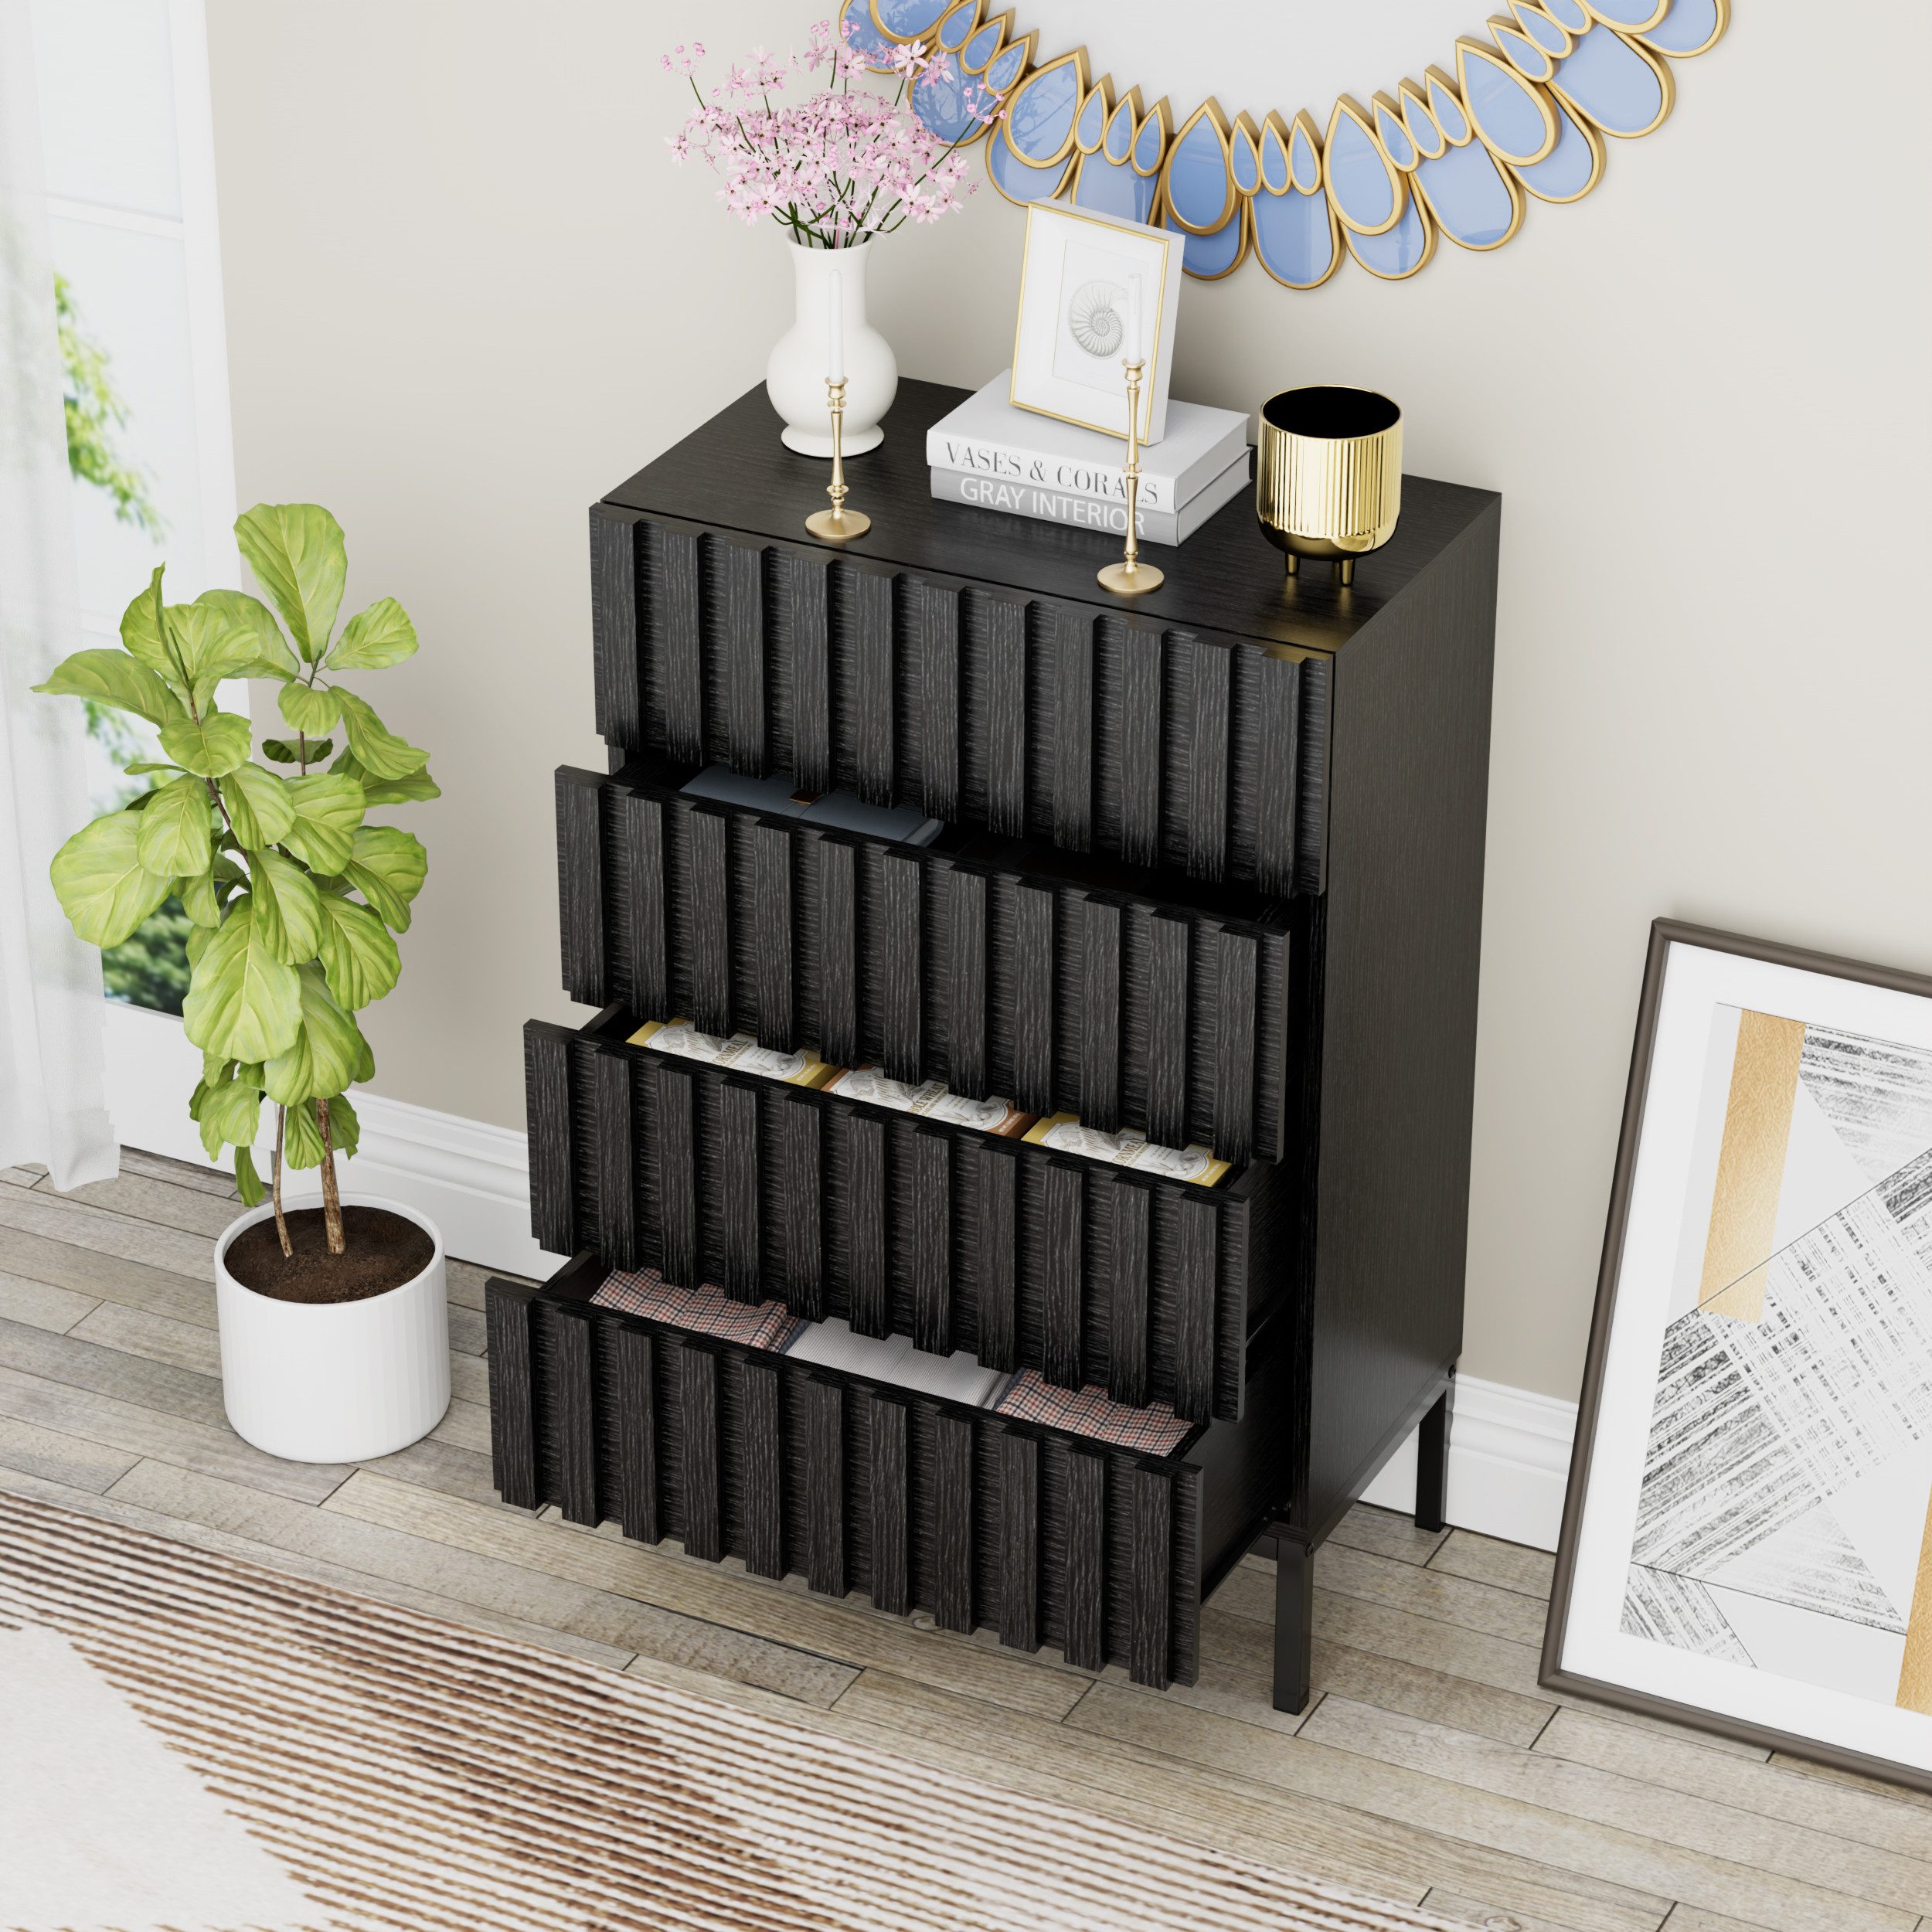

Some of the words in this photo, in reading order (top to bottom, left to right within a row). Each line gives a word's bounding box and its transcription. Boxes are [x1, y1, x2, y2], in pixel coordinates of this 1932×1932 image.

[946, 442, 1021, 477] VASES
[1029, 460, 1046, 482] &
[1057, 465, 1157, 504] CORAS
[961, 478, 1026, 512] GRAY
